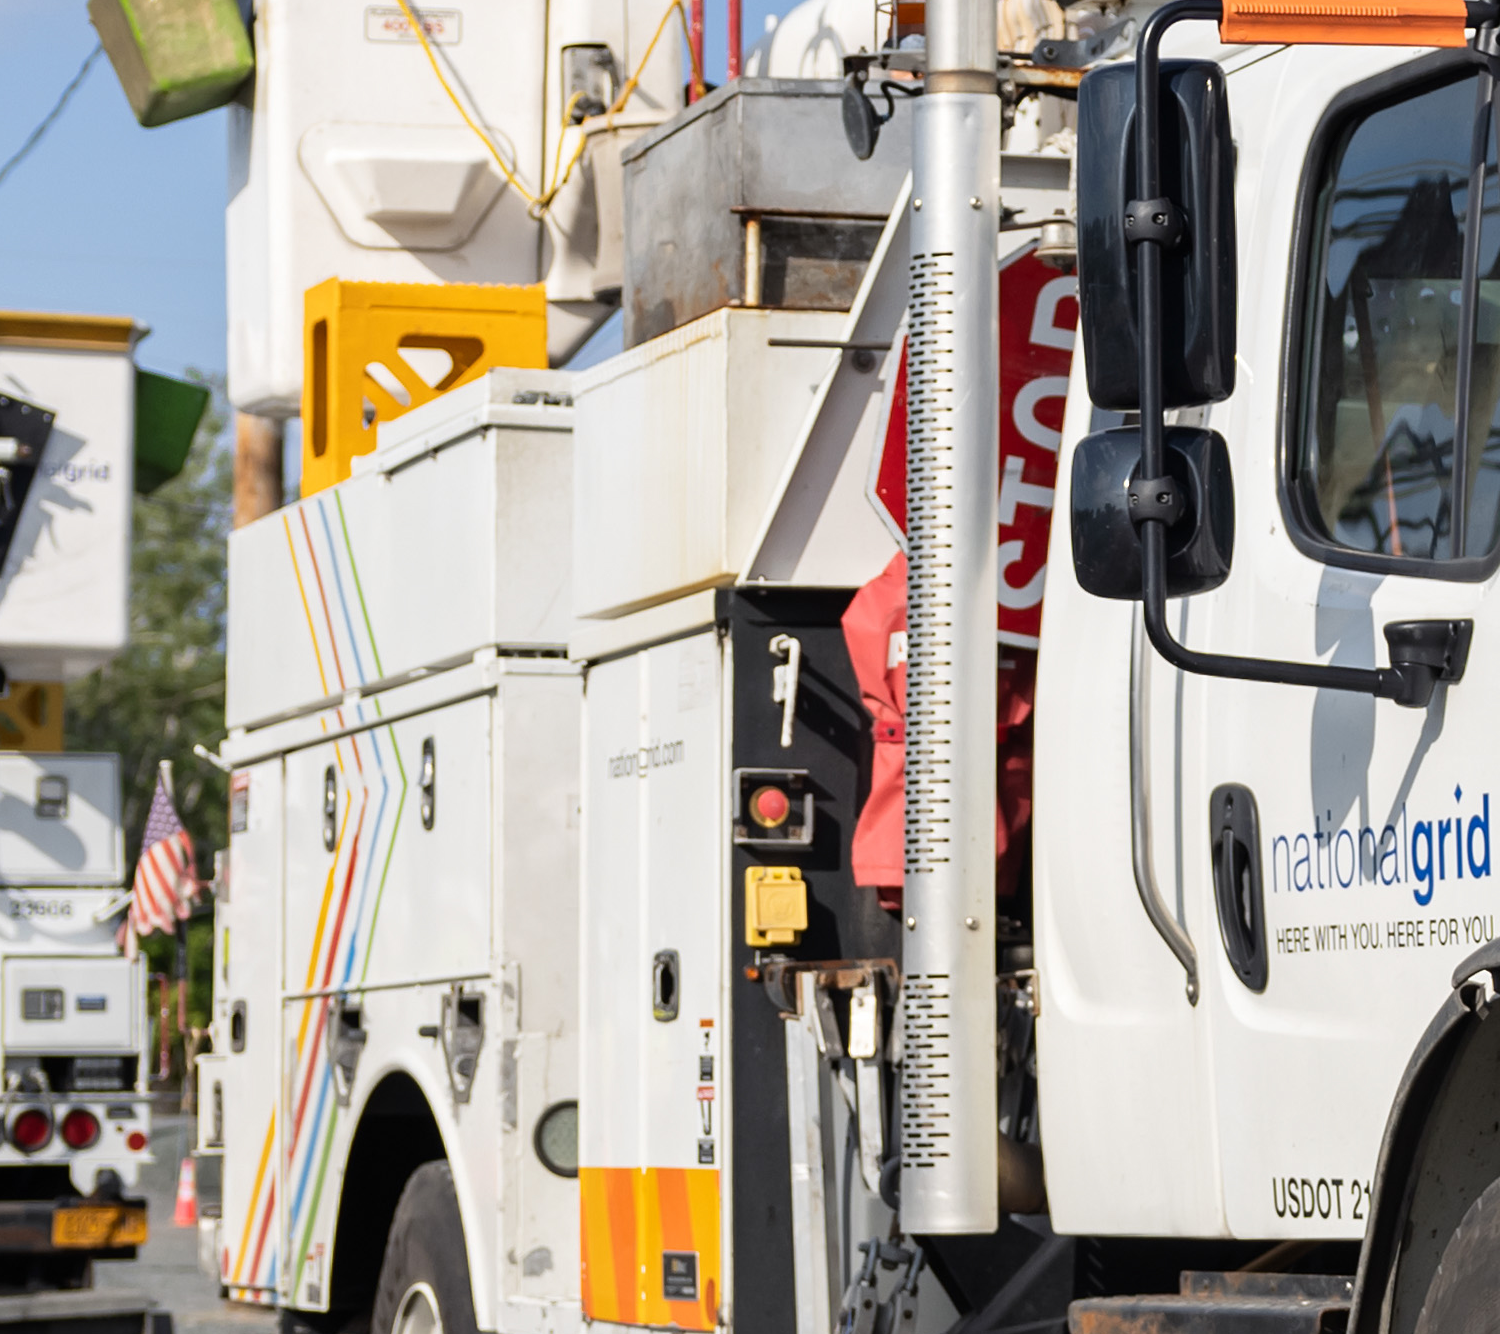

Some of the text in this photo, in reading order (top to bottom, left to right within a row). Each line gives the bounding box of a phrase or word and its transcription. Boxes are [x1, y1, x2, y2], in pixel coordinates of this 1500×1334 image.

[1272, 783, 1491, 907] nationalgrid
[1276, 914, 1494, 954] HERE WITH YOU. HERE FOR YOU
[1272, 1177, 1344, 1219] USDOT
